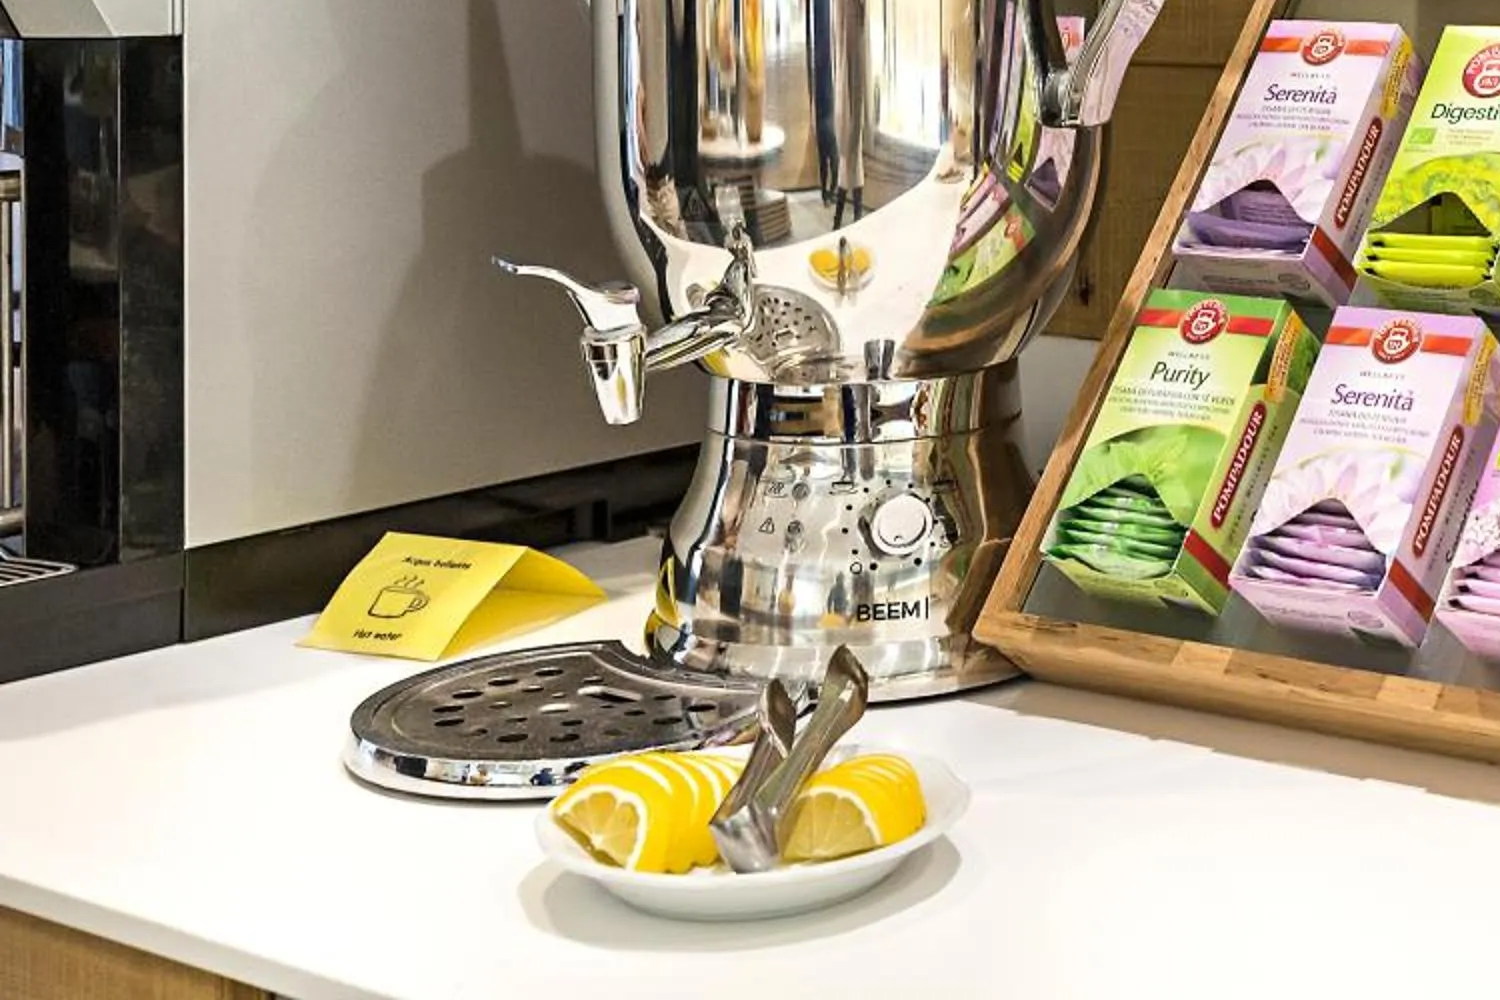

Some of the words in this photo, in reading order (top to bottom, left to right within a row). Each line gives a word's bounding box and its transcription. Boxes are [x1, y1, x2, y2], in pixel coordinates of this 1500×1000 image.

[1264, 83, 1338, 105] Serenità
[1337, 123, 1381, 223] POMPADOUR
[1151, 361, 1211, 391] Purity
[1332, 383, 1414, 412] Serenità
[1213, 409, 1264, 521] POMPADOUR
[1415, 434, 1461, 552] POMPADOUR
[857, 600, 921, 622] BEEM
